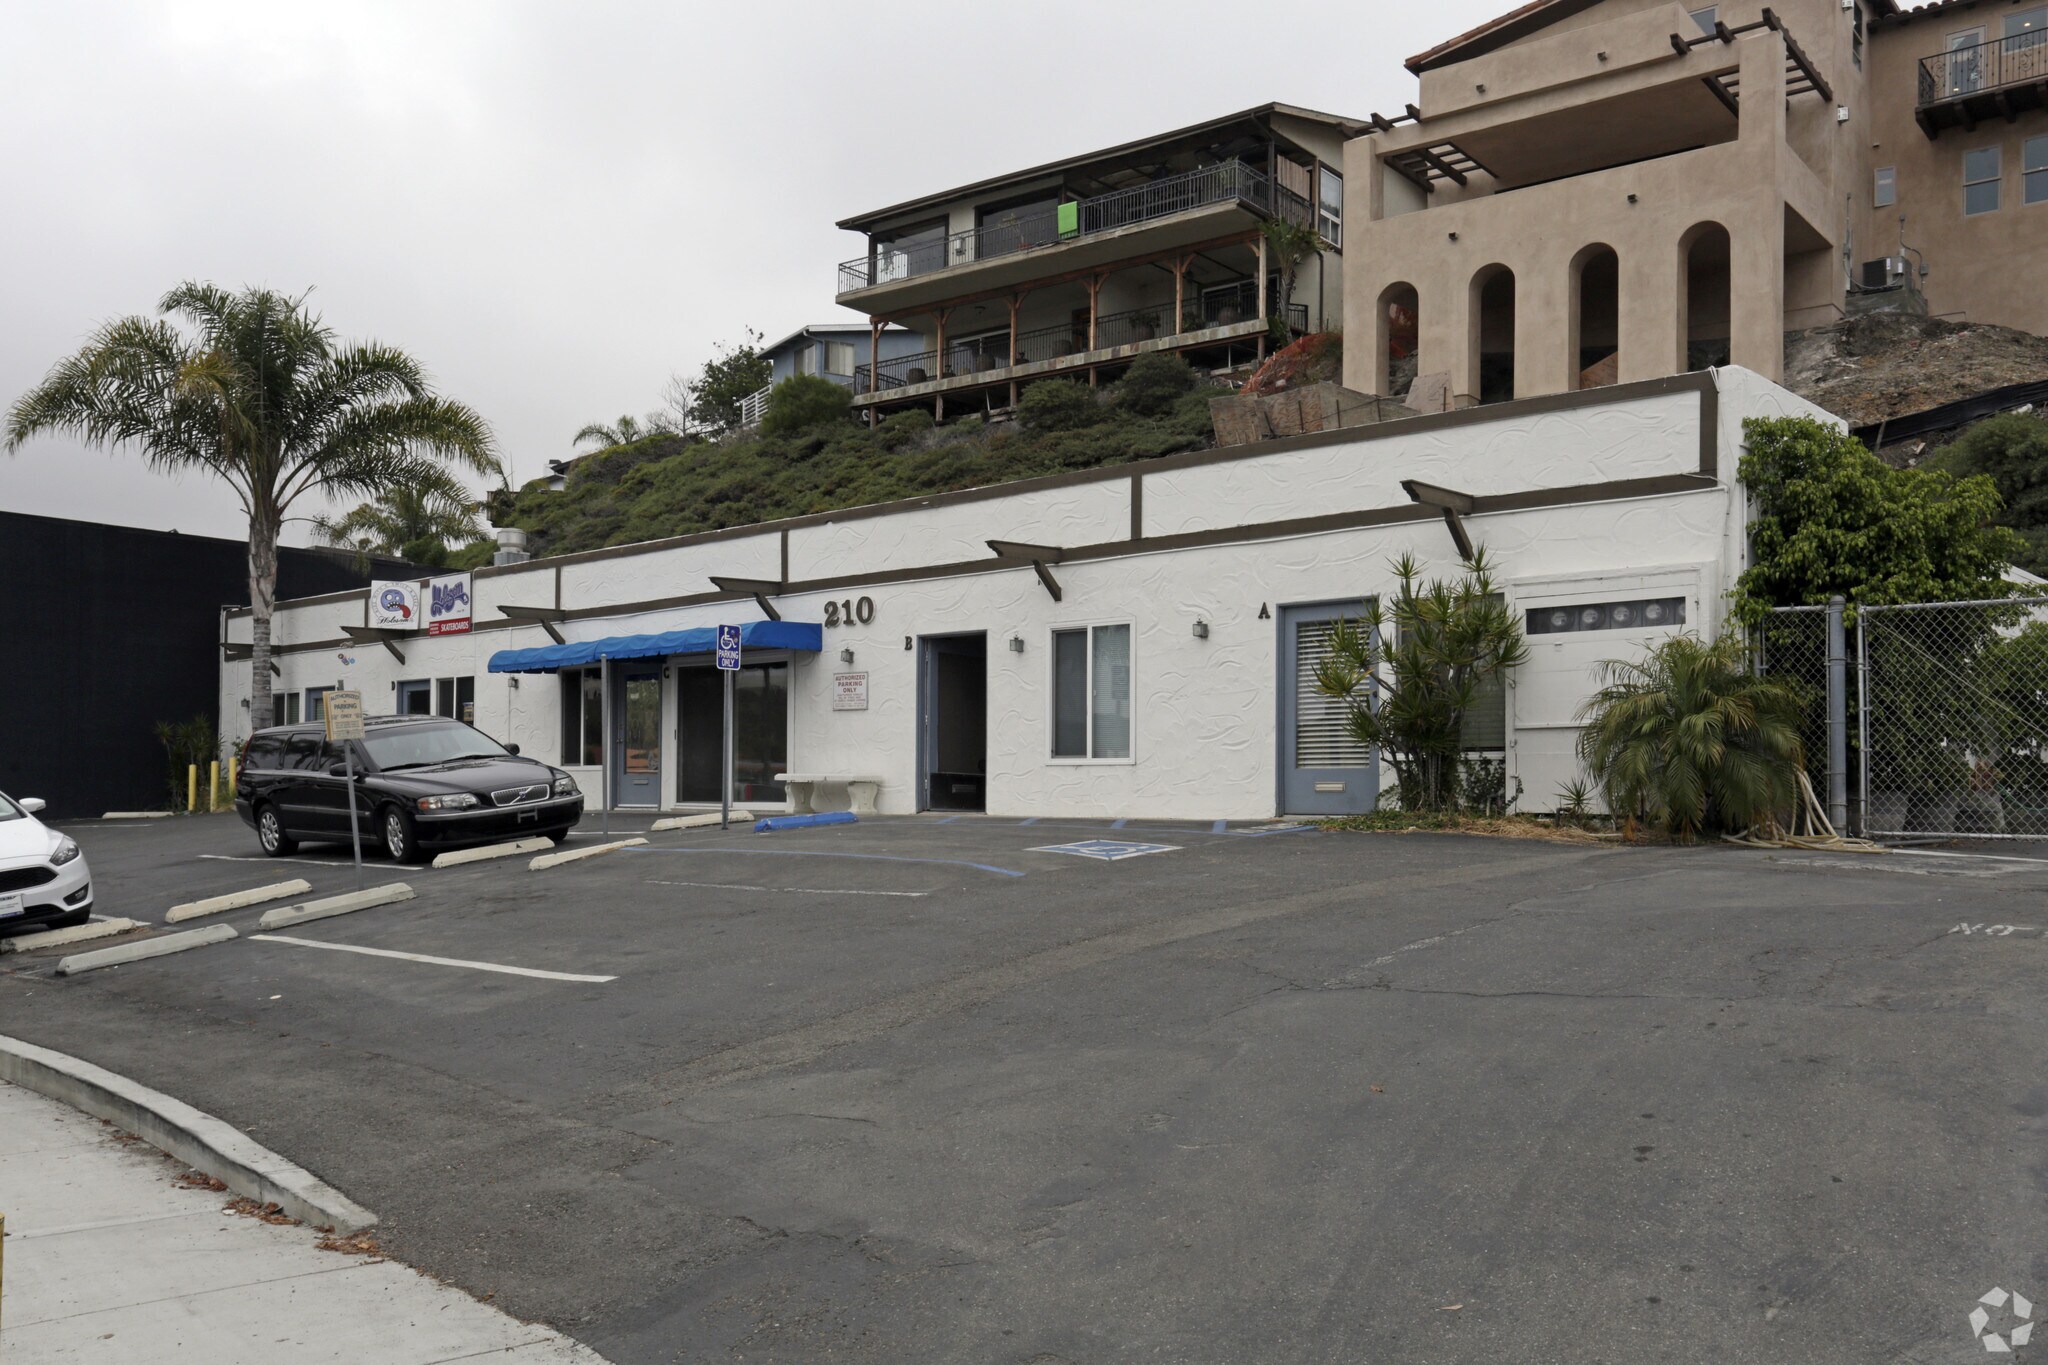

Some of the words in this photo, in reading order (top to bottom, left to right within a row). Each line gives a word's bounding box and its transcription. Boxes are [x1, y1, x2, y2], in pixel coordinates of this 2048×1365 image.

[824, 596, 875, 628] 210
[1258, 602, 1271, 619] A
[441, 621, 469, 632] SKATEBOARDS
[905, 636, 913, 651] B
[719, 649, 739, 660] PARKING
[722, 659, 735, 667] ONLY
[664, 667, 670, 679] C
